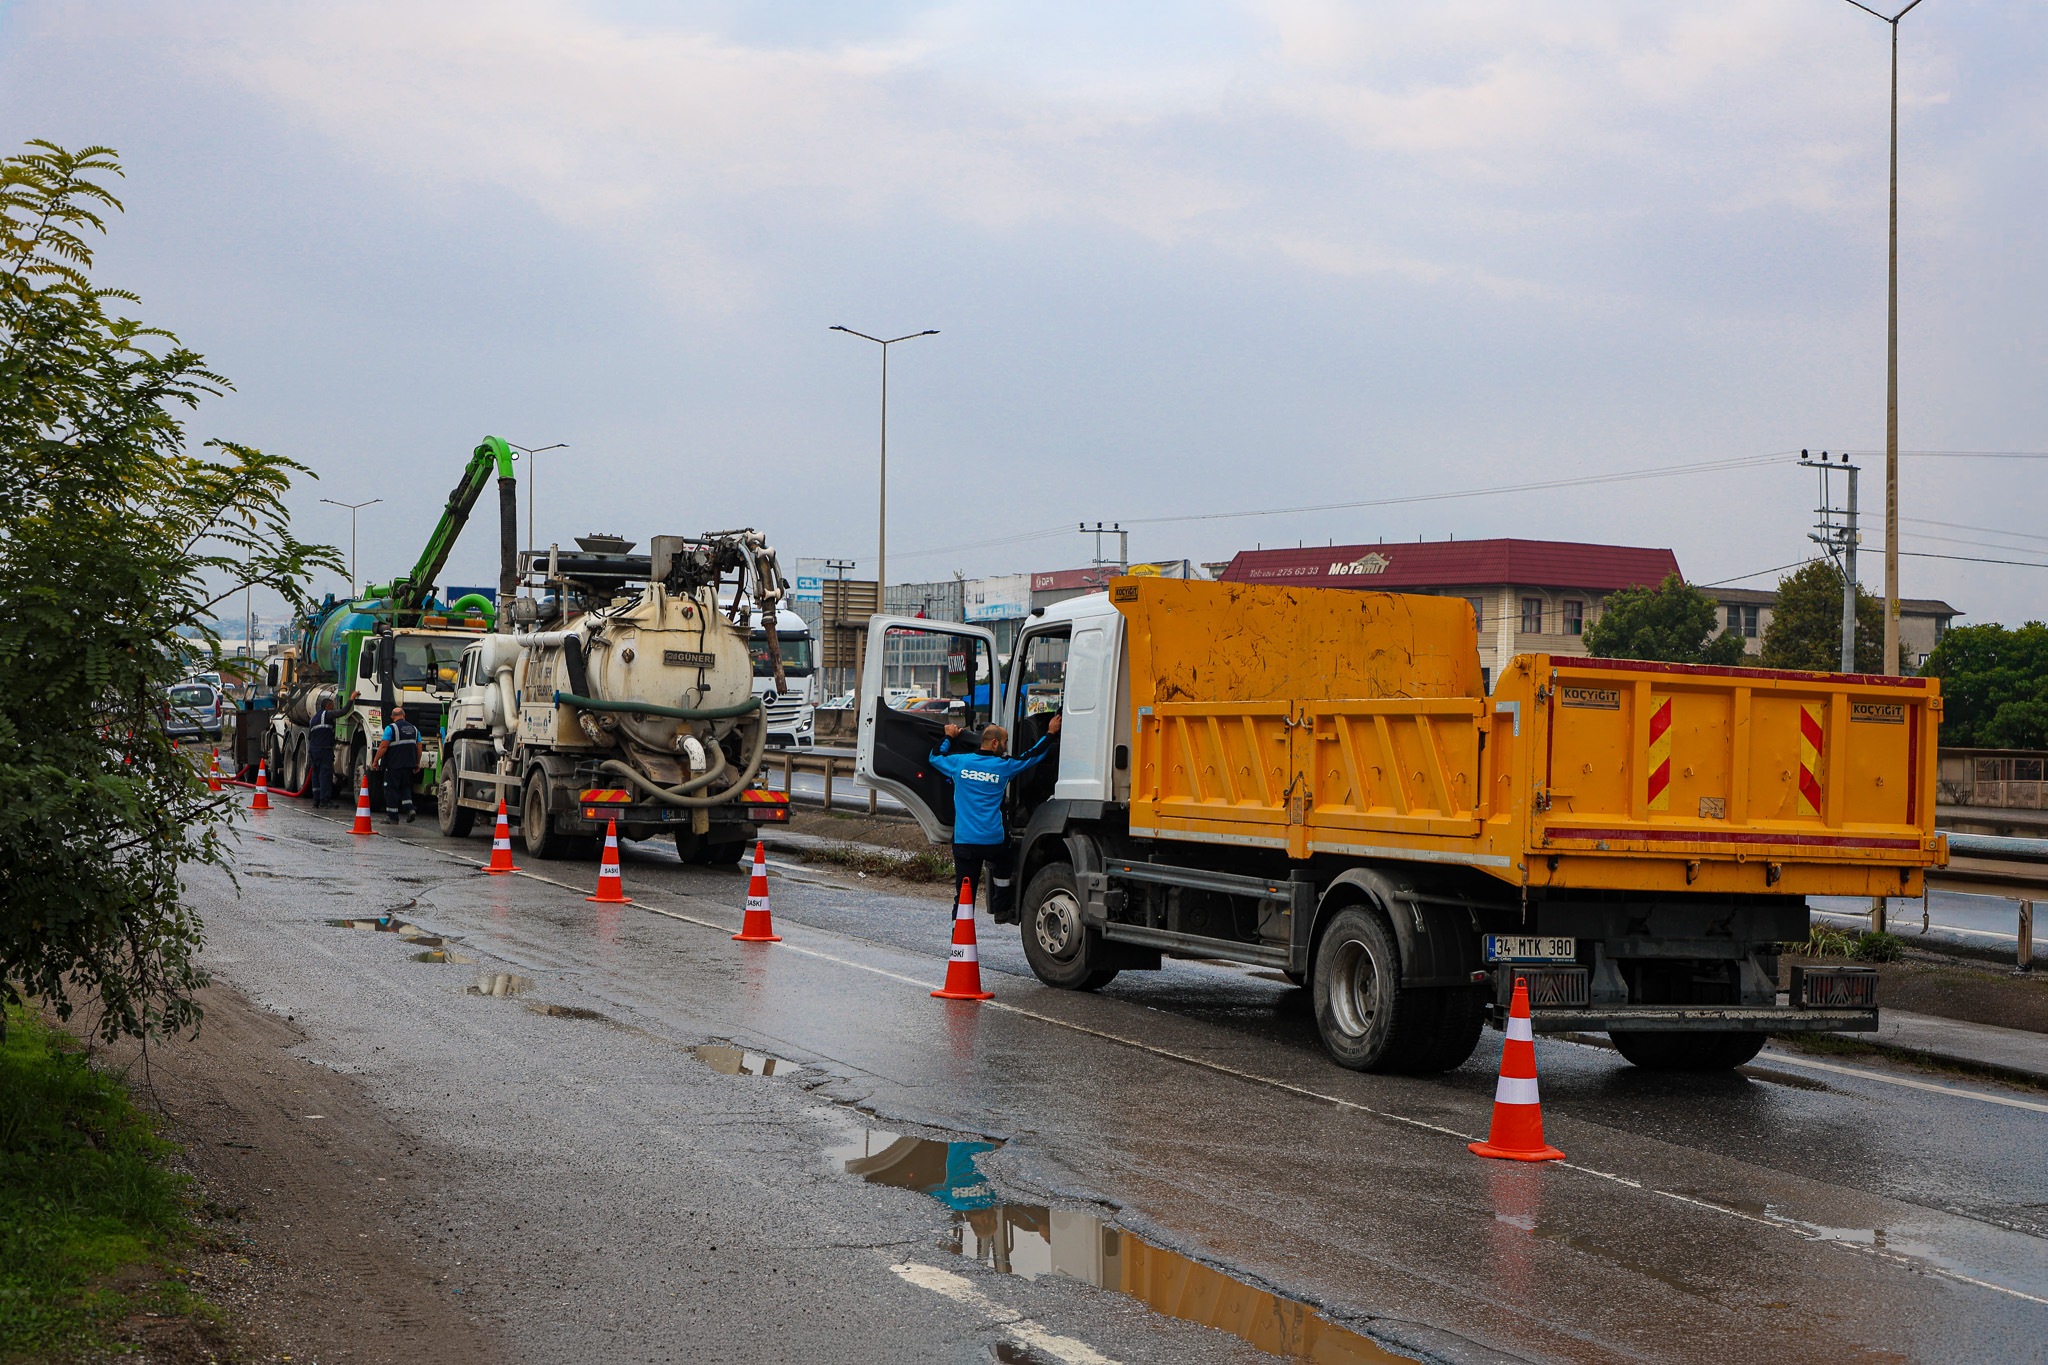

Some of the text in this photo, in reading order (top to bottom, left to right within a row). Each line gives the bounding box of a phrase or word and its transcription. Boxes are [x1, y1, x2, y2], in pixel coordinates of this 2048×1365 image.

[1276, 568, 1292, 576] 275
[1294, 567, 1306, 575] 63
[1307, 566, 1319, 575] 33
[1496, 939, 1511, 955] 34
[1518, 939, 1542, 956] MTK
[1549, 940, 1571, 956] 380
